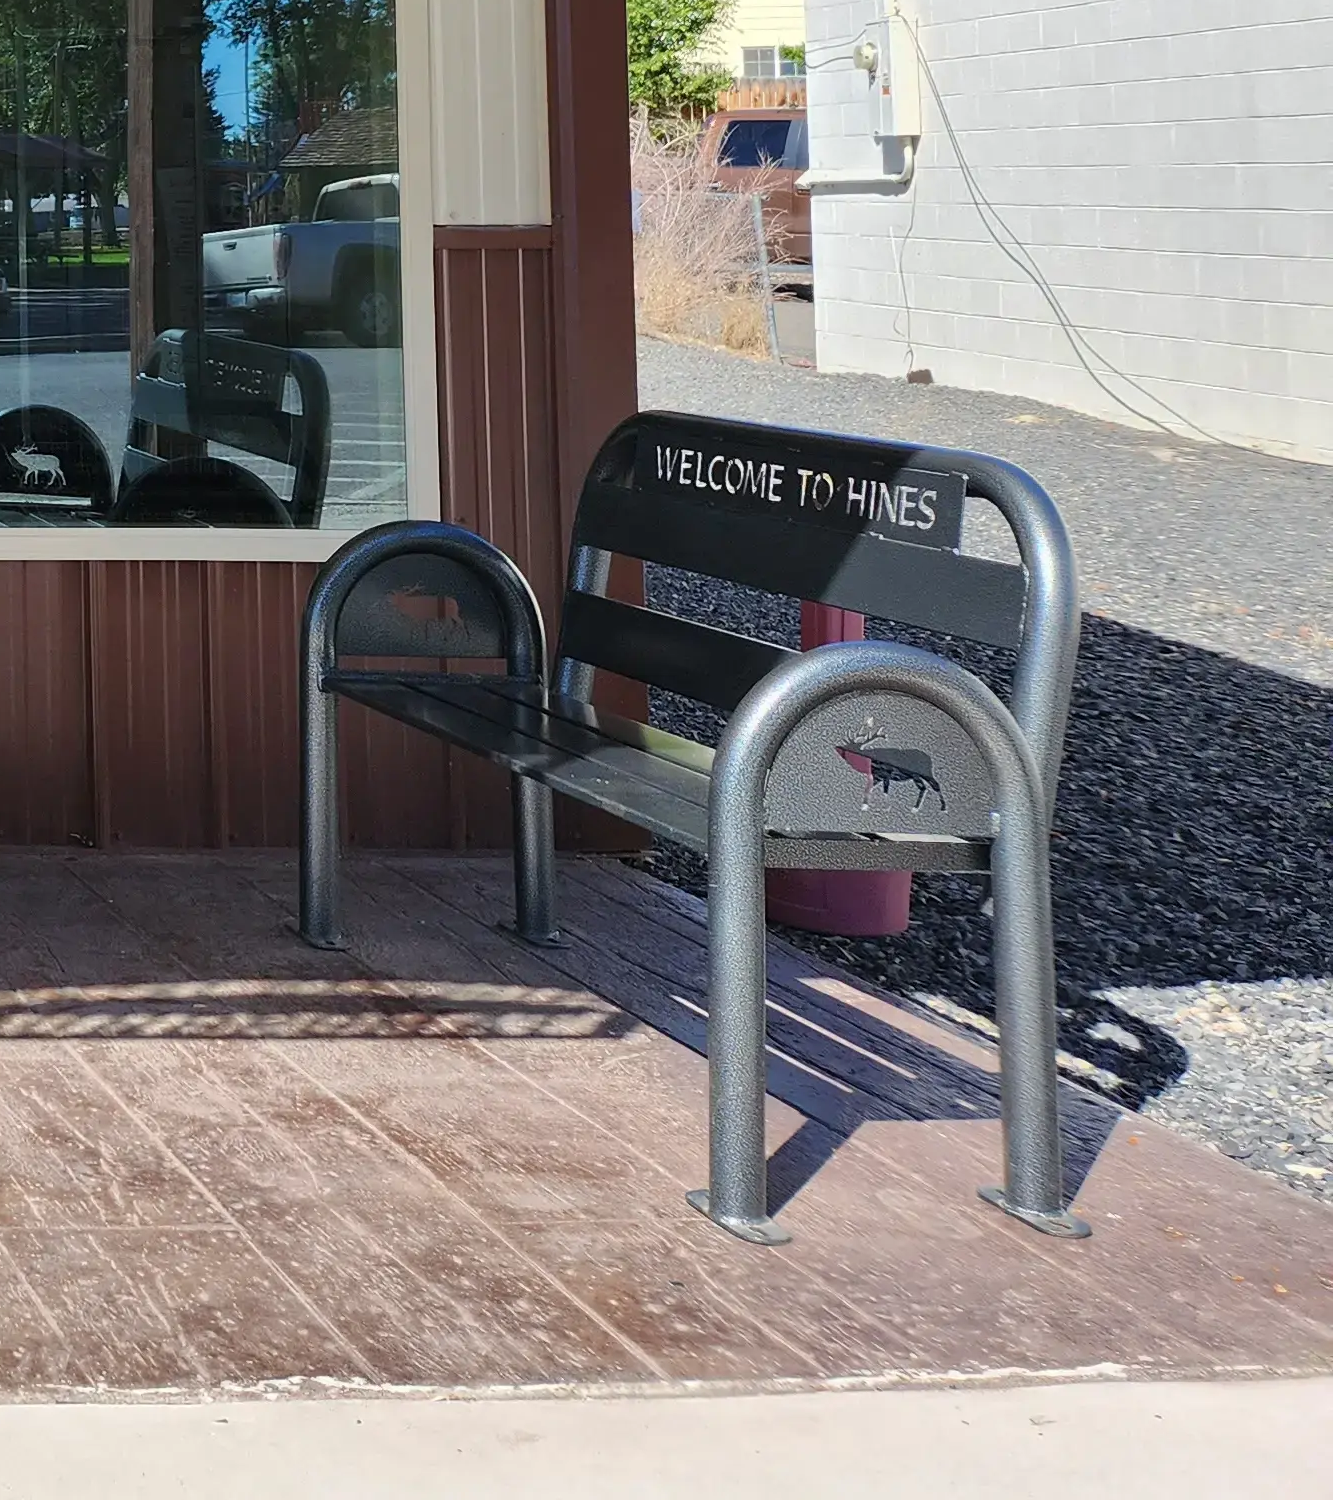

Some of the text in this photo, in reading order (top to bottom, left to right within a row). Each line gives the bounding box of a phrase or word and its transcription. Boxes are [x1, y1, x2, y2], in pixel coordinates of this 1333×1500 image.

[655, 444, 938, 531] WELCOME TO HINES
